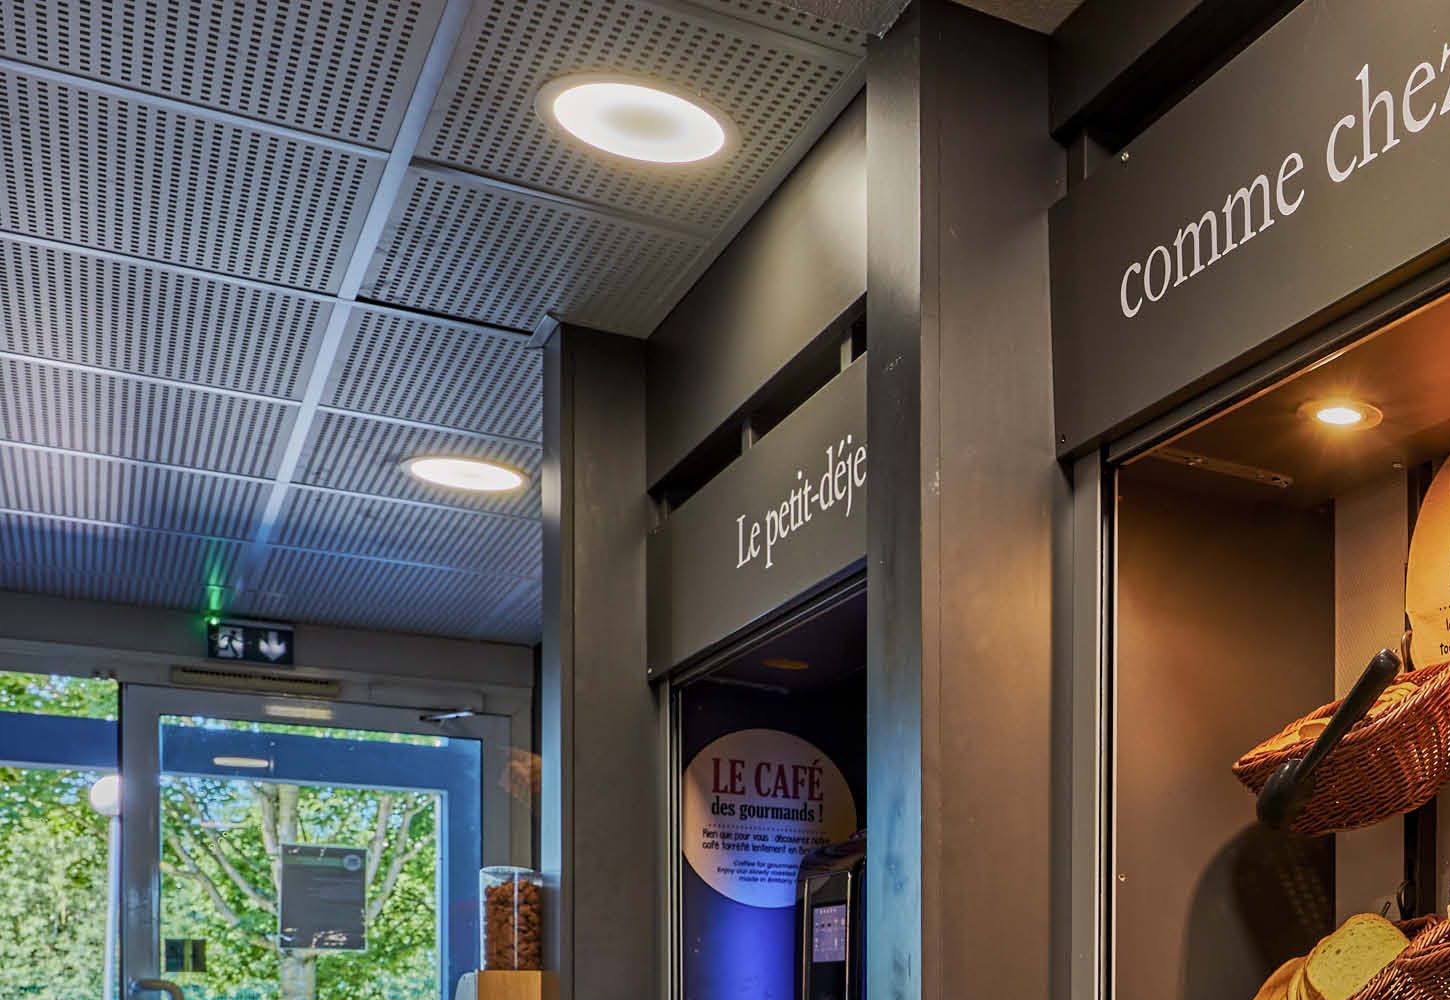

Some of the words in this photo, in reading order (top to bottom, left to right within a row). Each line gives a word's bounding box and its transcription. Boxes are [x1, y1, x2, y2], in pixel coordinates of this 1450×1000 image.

[1119, 151, 1306, 319] comme
[736, 514, 761, 569] Le
[765, 434, 867, 569] petit-déje
[711, 758, 745, 795] LE
[754, 760, 824, 801] CAFÉ
[711, 796, 735, 816] des
[739, 803, 815, 823] gourmands
[819, 805, 824, 823] !
[702, 828, 718, 838] Rien
[719, 831, 734, 840] que
[734, 832, 751, 841] pour
[753, 833, 769, 842] vous
[702, 840, 720, 850] café
